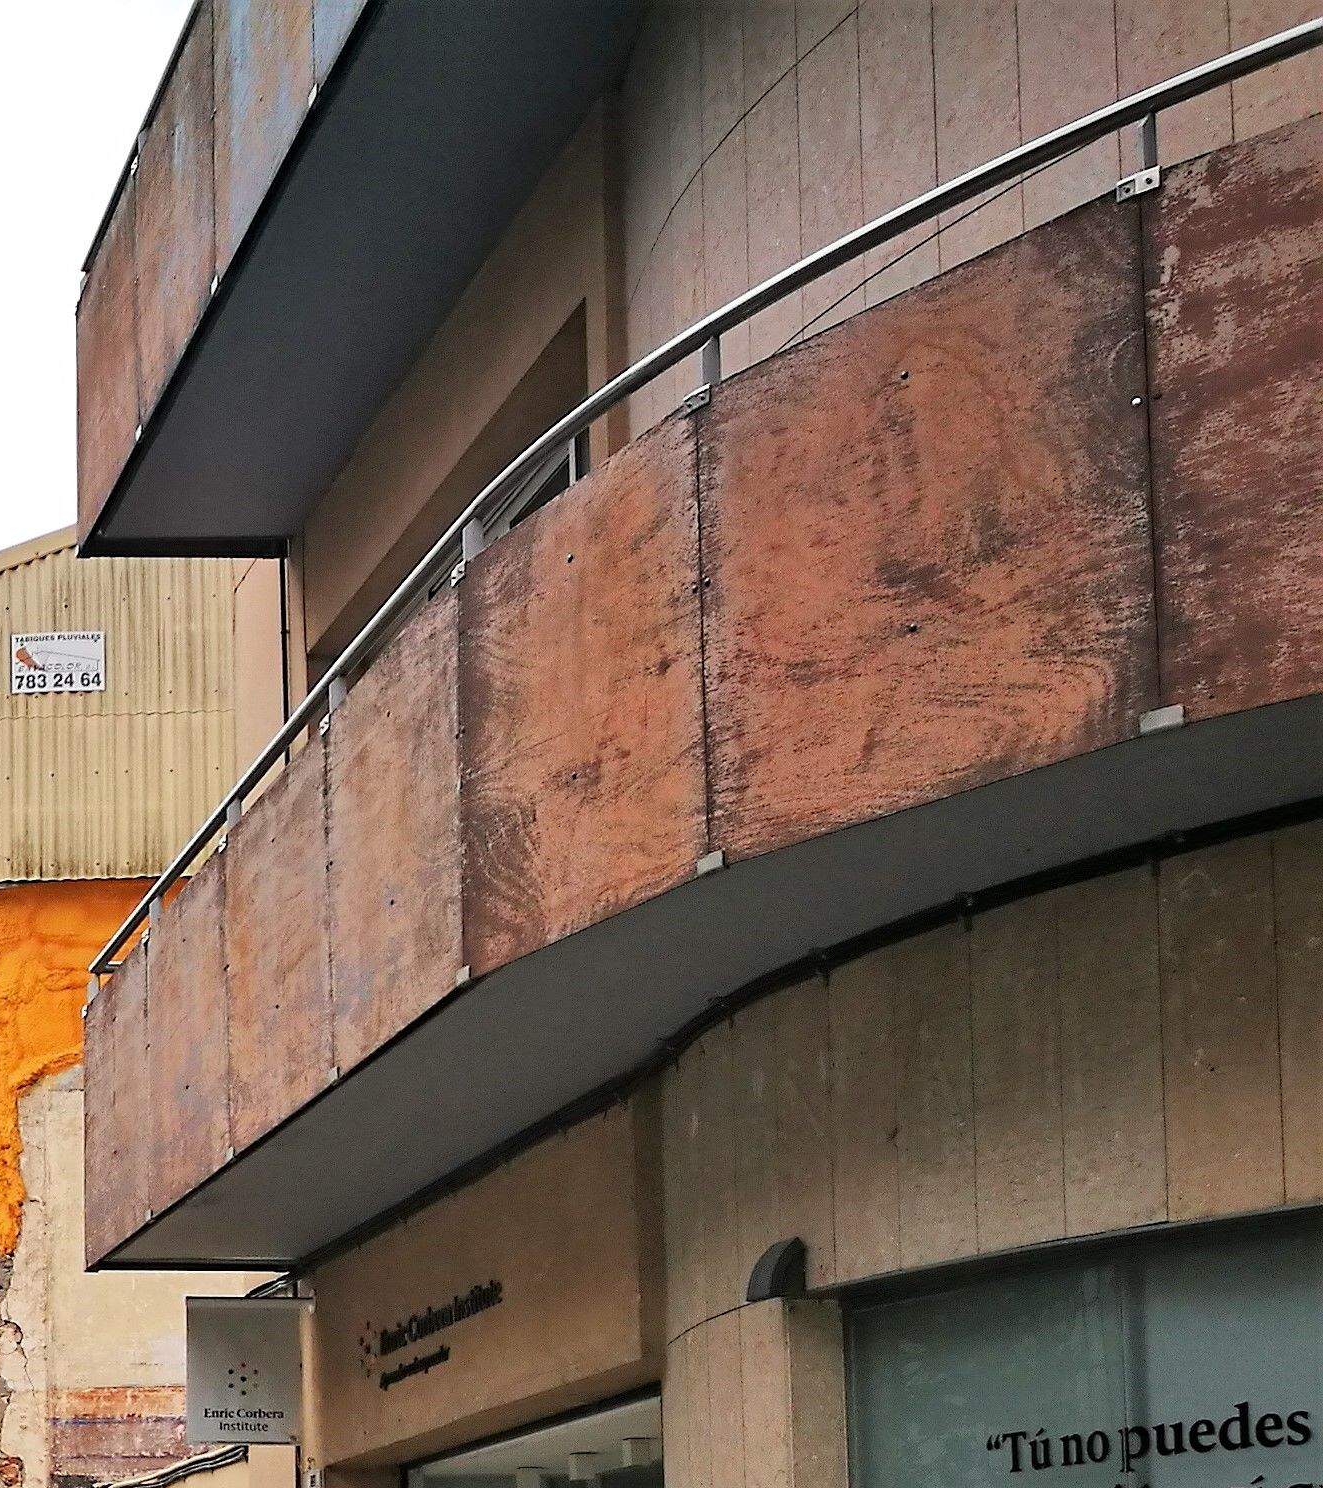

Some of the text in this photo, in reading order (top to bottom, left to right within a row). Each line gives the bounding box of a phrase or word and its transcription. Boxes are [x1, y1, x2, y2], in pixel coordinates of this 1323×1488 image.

[15, 634, 102, 644] TABIQUES PLUVIALES
[15, 672, 102, 690] 783 24 64
[204, 1407, 284, 1419] Enric Corbera
[219, 1421, 269, 1432] Institute
[1060, 1430, 1110, 1467] no
[1119, 1401, 1312, 1473] puedes
